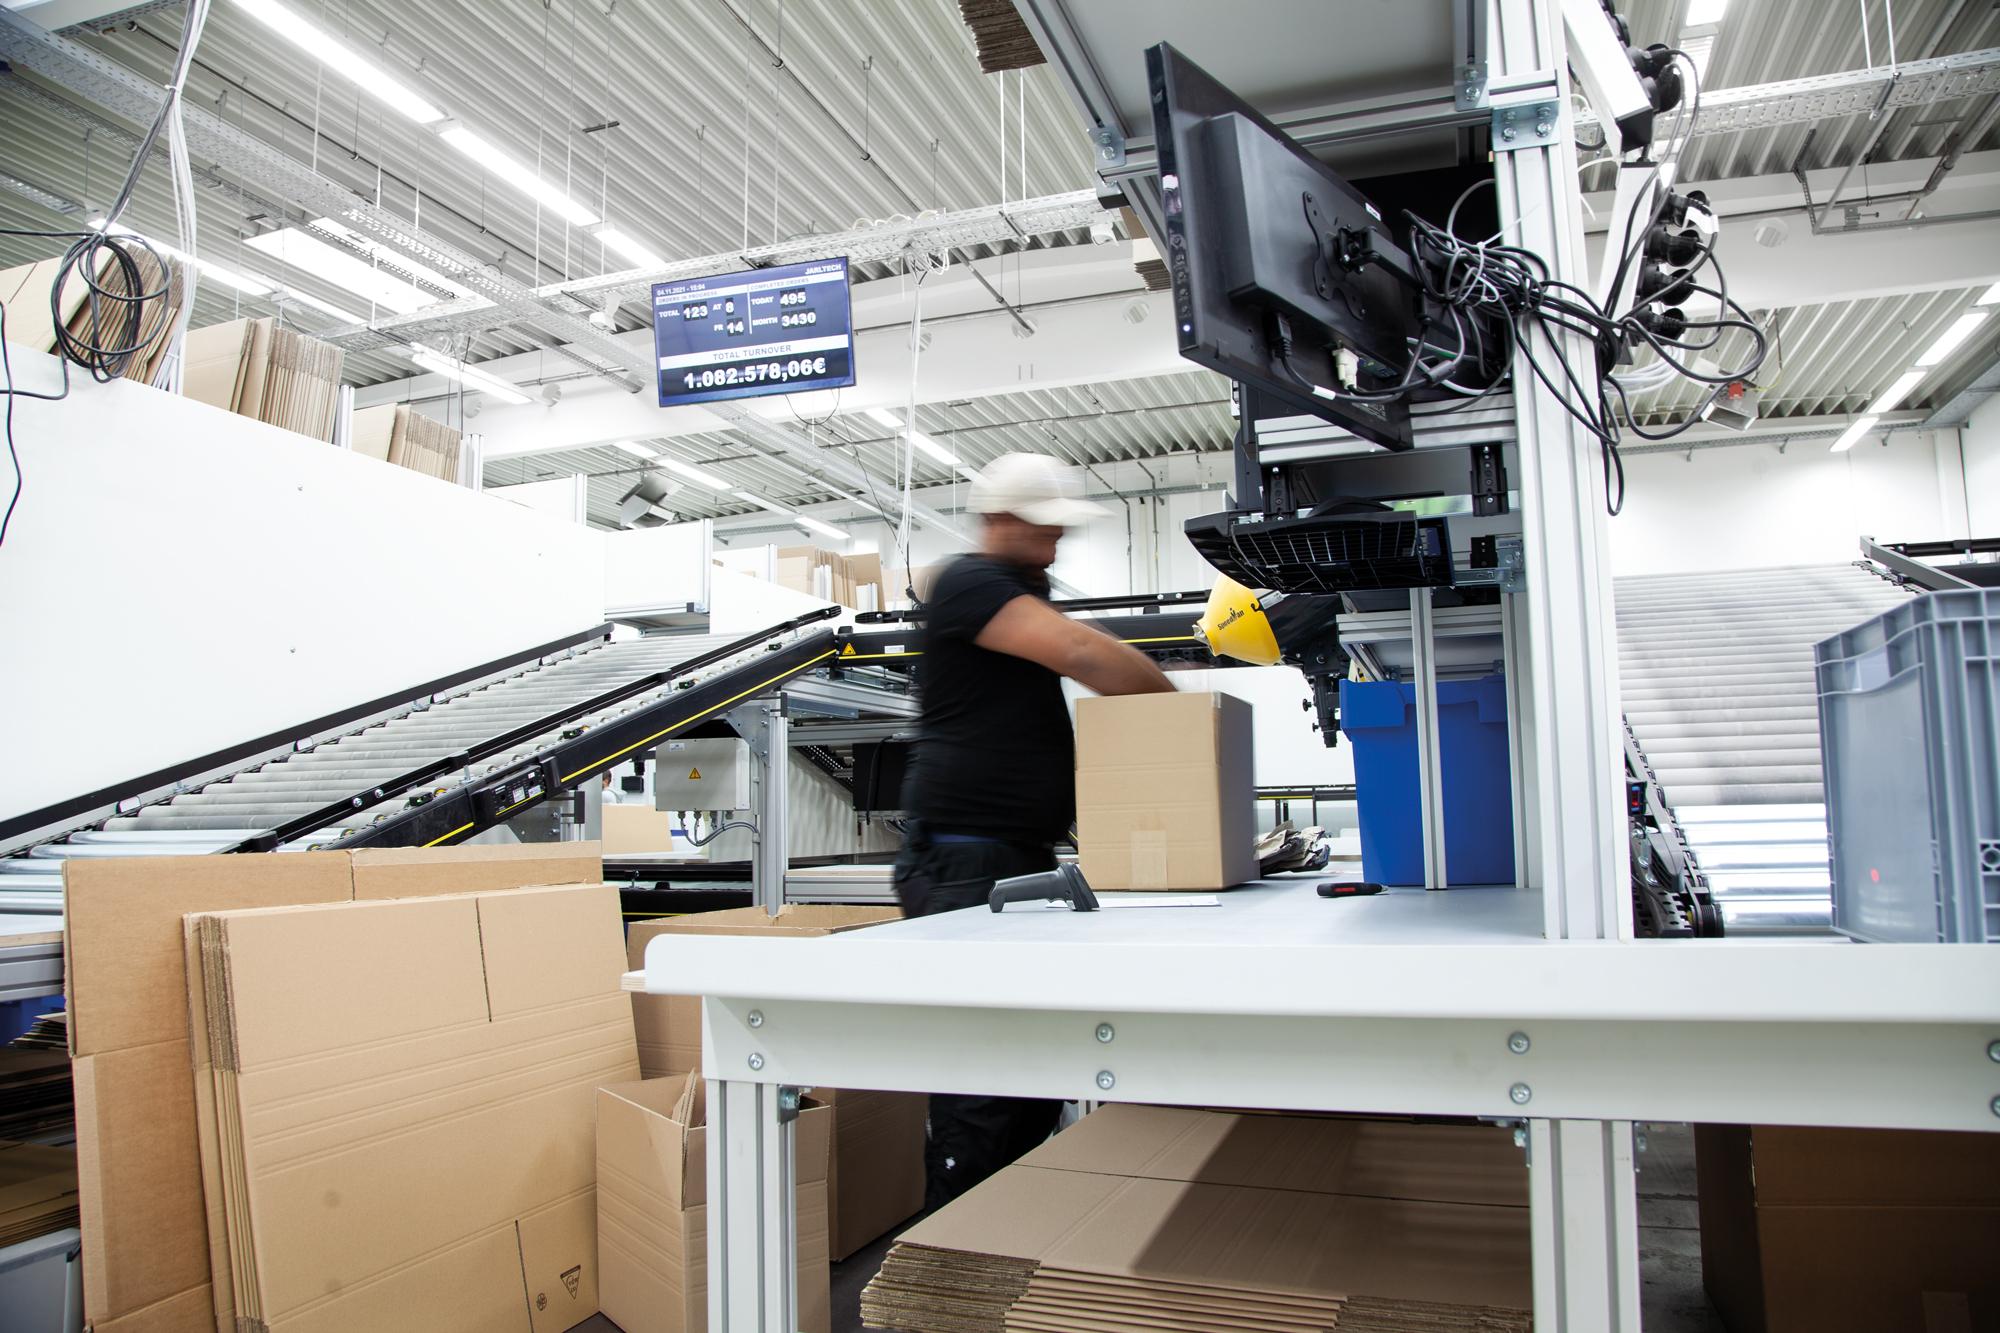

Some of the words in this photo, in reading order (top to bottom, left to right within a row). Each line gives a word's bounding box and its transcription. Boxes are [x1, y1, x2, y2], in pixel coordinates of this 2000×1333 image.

[805, 264, 841, 274] JARLTECH
[751, 296, 774, 305] TODAY
[780, 292, 806, 306] 495
[659, 310, 680, 318] TOTAL
[683, 305, 708, 319] 123
[713, 303, 722, 311] AT
[725, 301, 734, 313] 8
[752, 317, 778, 326] MONTH
[781, 312, 816, 327] 3430
[727, 321, 744, 334] 14
[713, 352, 740, 361] TOTAL
[743, 344, 792, 357] TURNOVER
[684, 357, 827, 389] 1.082.578,06€
